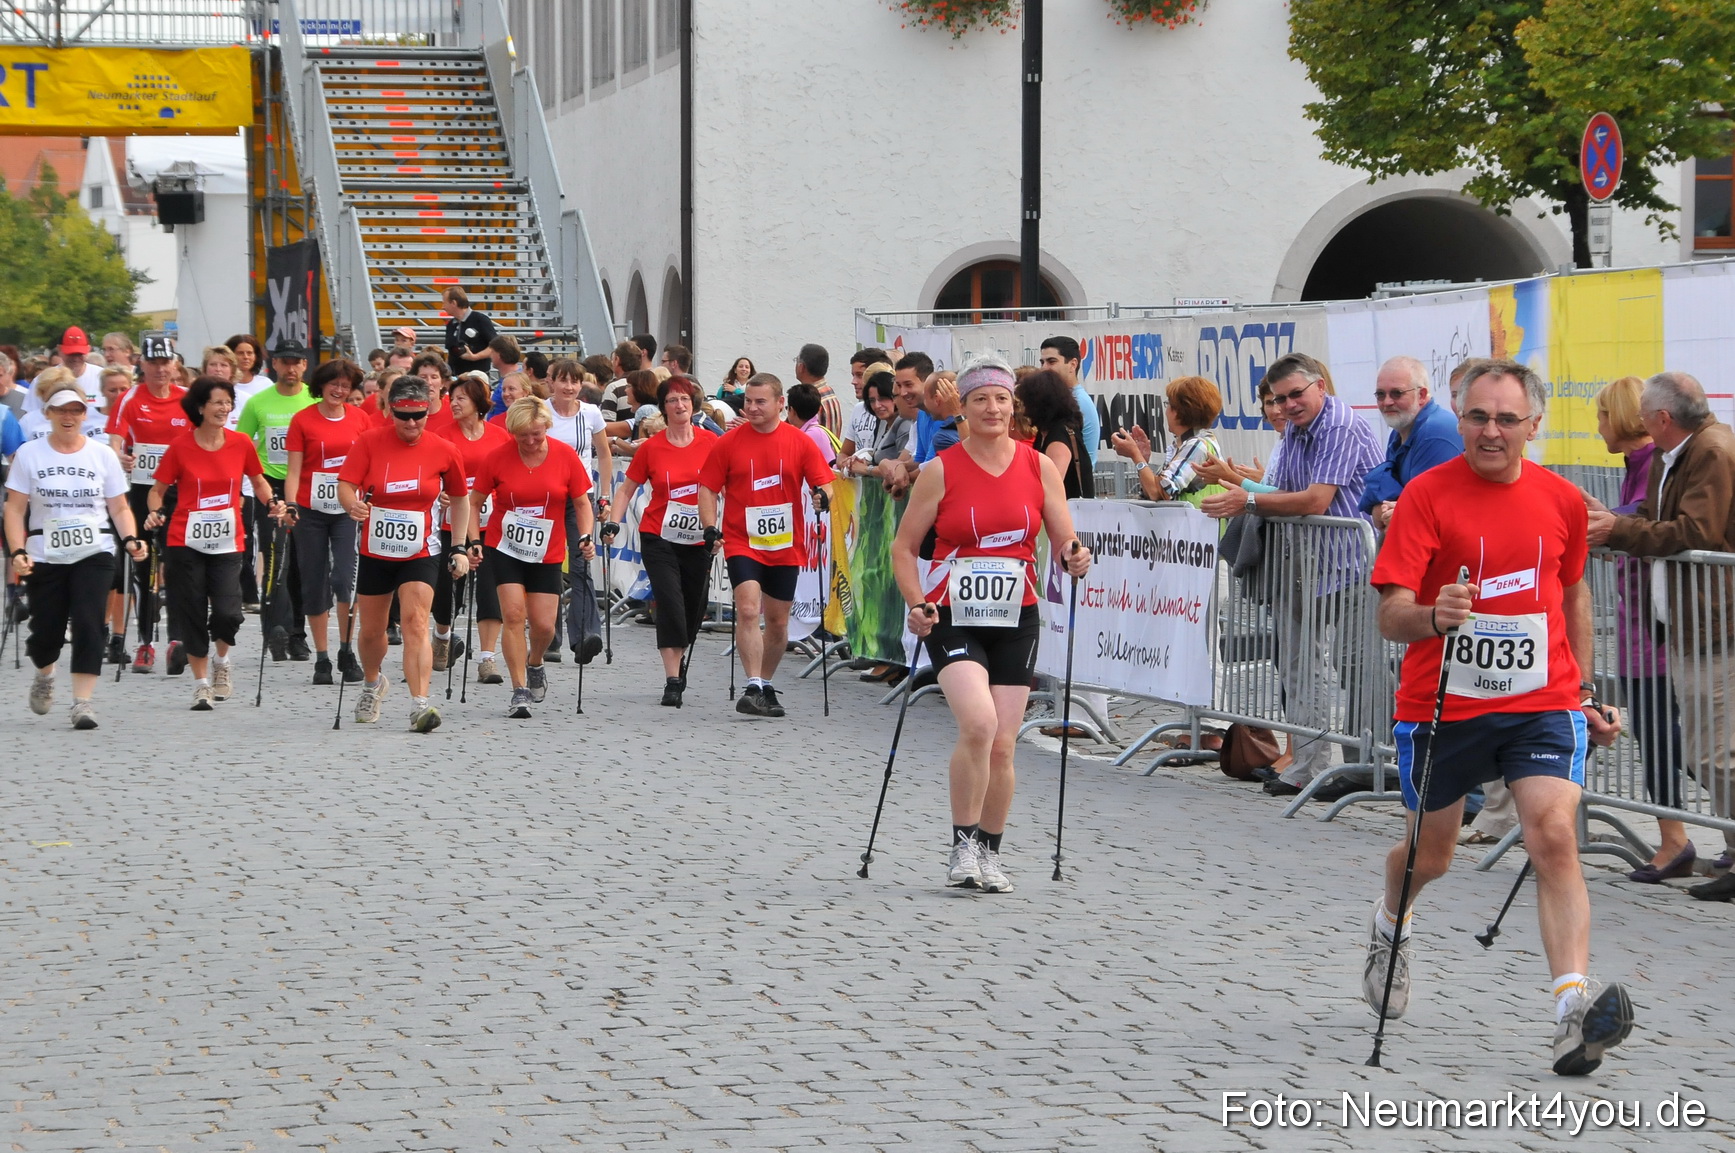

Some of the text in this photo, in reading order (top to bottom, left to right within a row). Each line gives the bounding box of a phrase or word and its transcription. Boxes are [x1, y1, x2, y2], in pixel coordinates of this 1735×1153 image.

[87, 90, 218, 102] Neumarkter Stadtlauf
[1095, 333, 1163, 381] INTERSPORT
[271, 437, 287, 450] 80
[138, 454, 161, 469] 80
[37, 466, 96, 481] BERGER
[36, 487, 100, 499] POWER GIRLS
[317, 484, 335, 499] 80
[192, 521, 230, 539] 8034
[375, 520, 418, 541] 8039
[757, 516, 785, 535] 864
[50, 527, 94, 548] 8089
[506, 523, 544, 547] 8019
[677, 531, 695, 540] Rosa
[992, 535, 1013, 543] DEHN
[381, 542, 408, 553] Brigitte
[971, 561, 1005, 570] BOCK
[959, 575, 1017, 601] 8007
[1495, 577, 1521, 591] DEHN
[1136, 582, 1147, 615] in
[964, 606, 1008, 618] Marianne
[1474, 620, 1519, 632] BOCK
[1456, 634, 1535, 670] 8033
[1474, 675, 1513, 692] Josef
